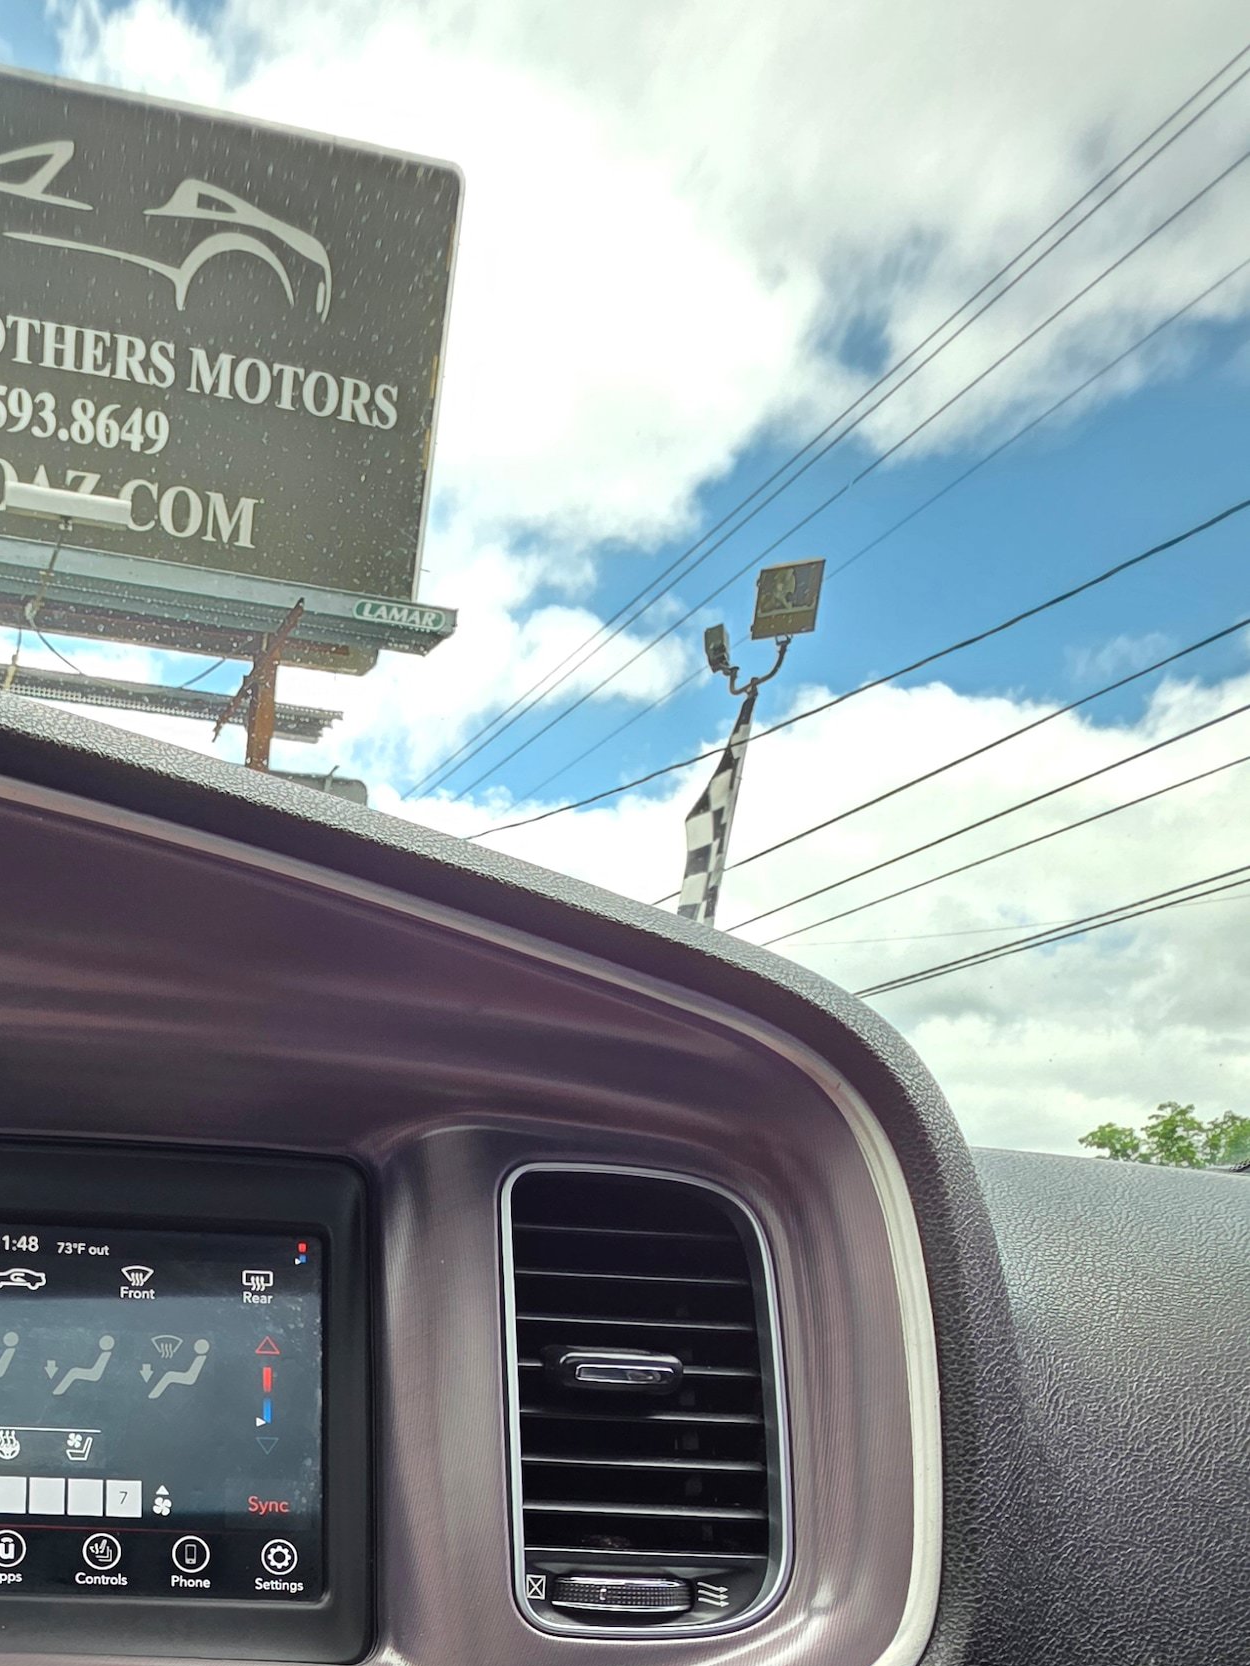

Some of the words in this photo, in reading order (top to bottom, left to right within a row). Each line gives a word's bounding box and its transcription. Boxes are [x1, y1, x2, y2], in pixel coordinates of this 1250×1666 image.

[187, 347, 400, 431] MOTORS
[362, 602, 437, 627] LAMAR
[56, 1241, 87, 1255] 73°F
[88, 1244, 110, 1256] out
[119, 1286, 155, 1300] Front
[242, 1291, 273, 1305] Rear
[118, 1490, 129, 1505] 7
[247, 1495, 291, 1517] Sync
[75, 1571, 128, 1587] Controls
[171, 1574, 211, 1589] Phone
[254, 1578, 304, 1593] Settings
